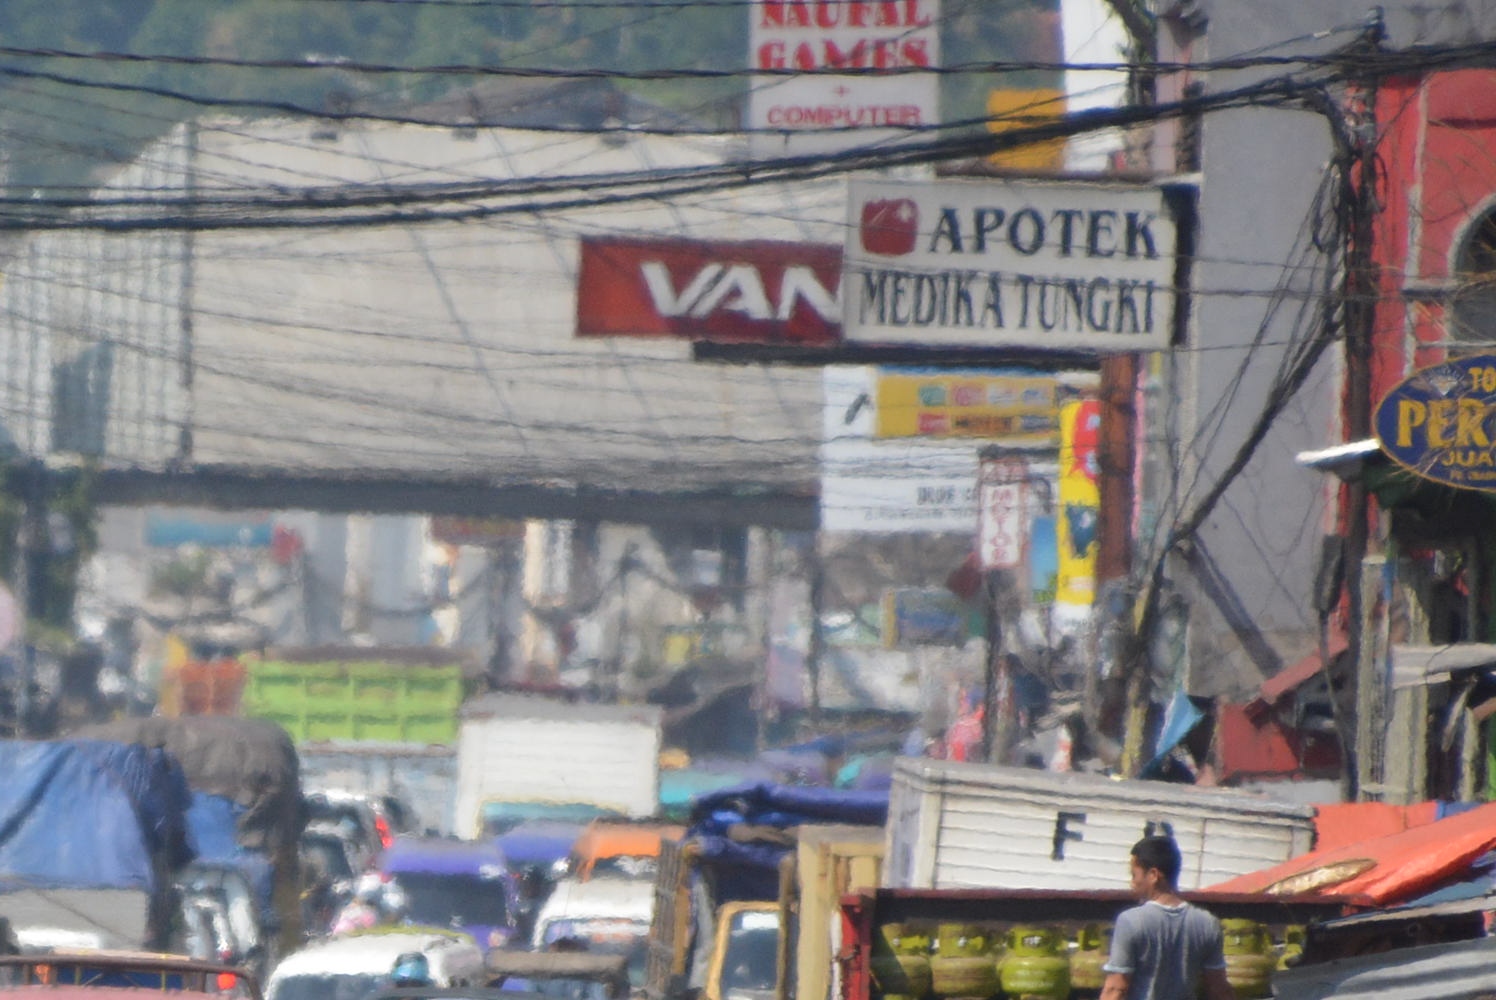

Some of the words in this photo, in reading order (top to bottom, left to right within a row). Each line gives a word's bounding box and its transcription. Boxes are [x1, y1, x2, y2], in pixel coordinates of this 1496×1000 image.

[761, 0, 930, 28] NAUFAL
[758, 39, 929, 74] GAMES
[767, 104, 921, 126] COMPUTER
[930, 207, 1159, 260] APOTEK
[859, 268, 1004, 328] MEDIKA
[1016, 274, 1156, 334] TUNGKI
